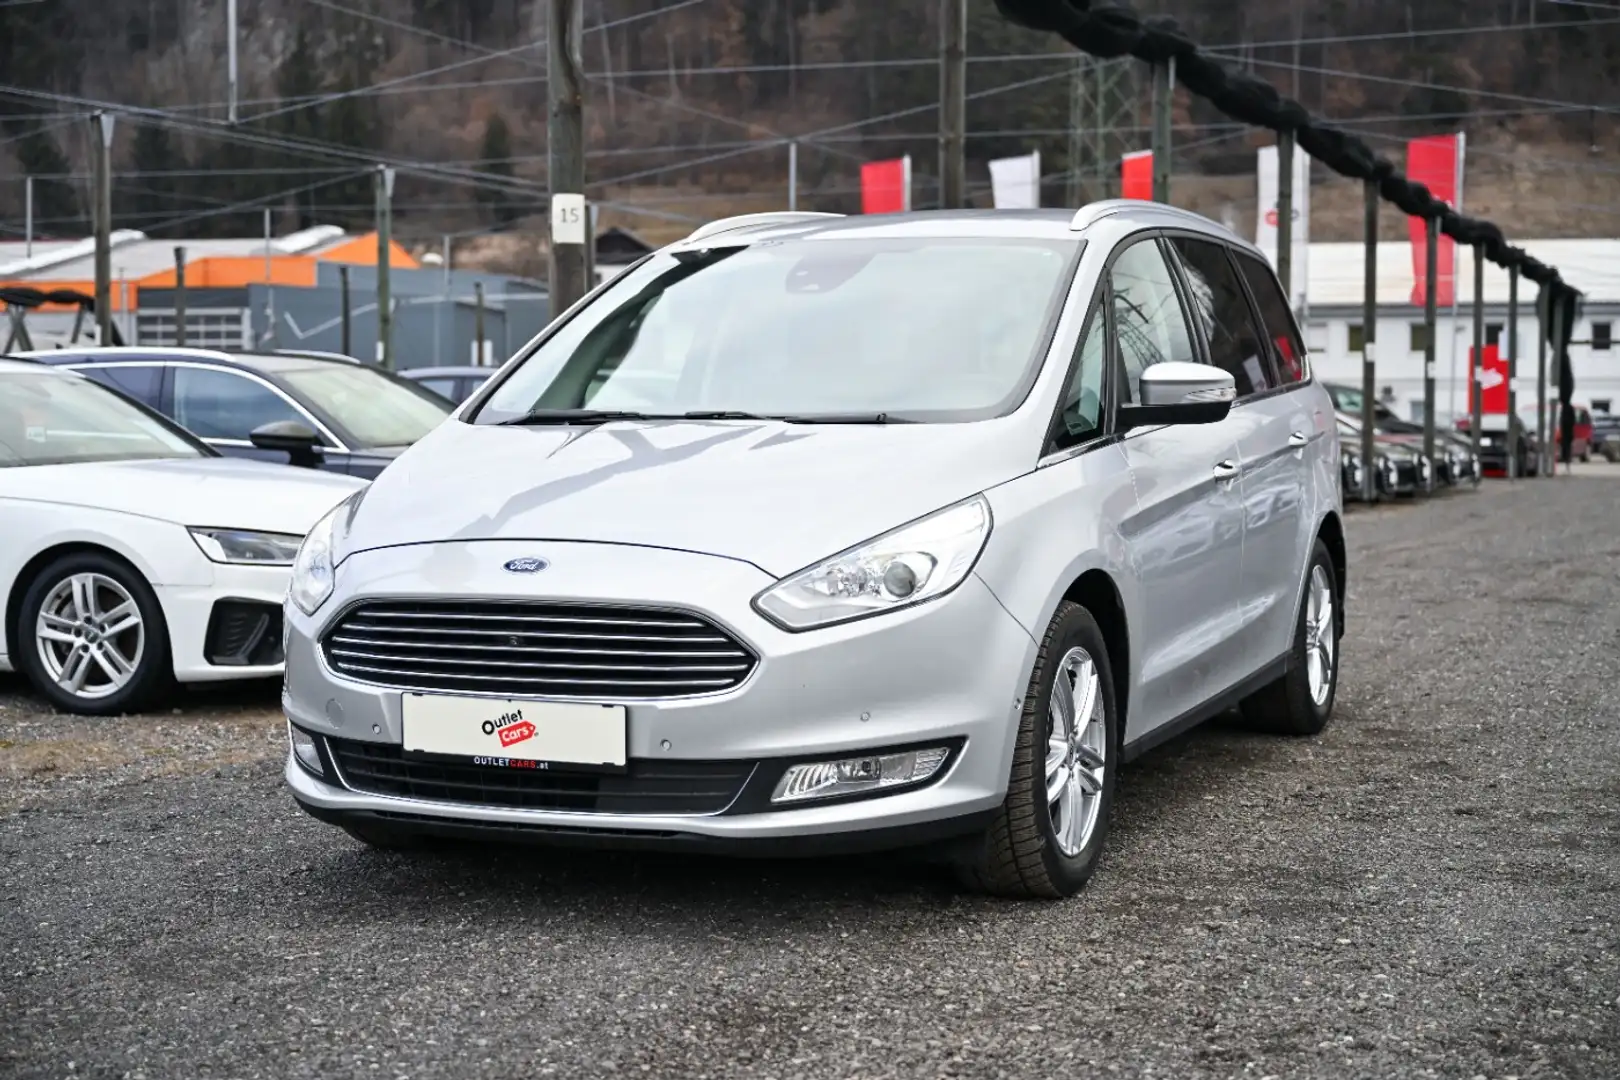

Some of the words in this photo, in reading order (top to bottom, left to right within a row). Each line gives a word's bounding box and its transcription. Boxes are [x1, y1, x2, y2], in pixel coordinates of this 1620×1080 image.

[560, 207, 580, 224] 15
[510, 560, 540, 570] Ford
[481, 709, 523, 735] Outlet
[502, 726, 530, 742] Cars
